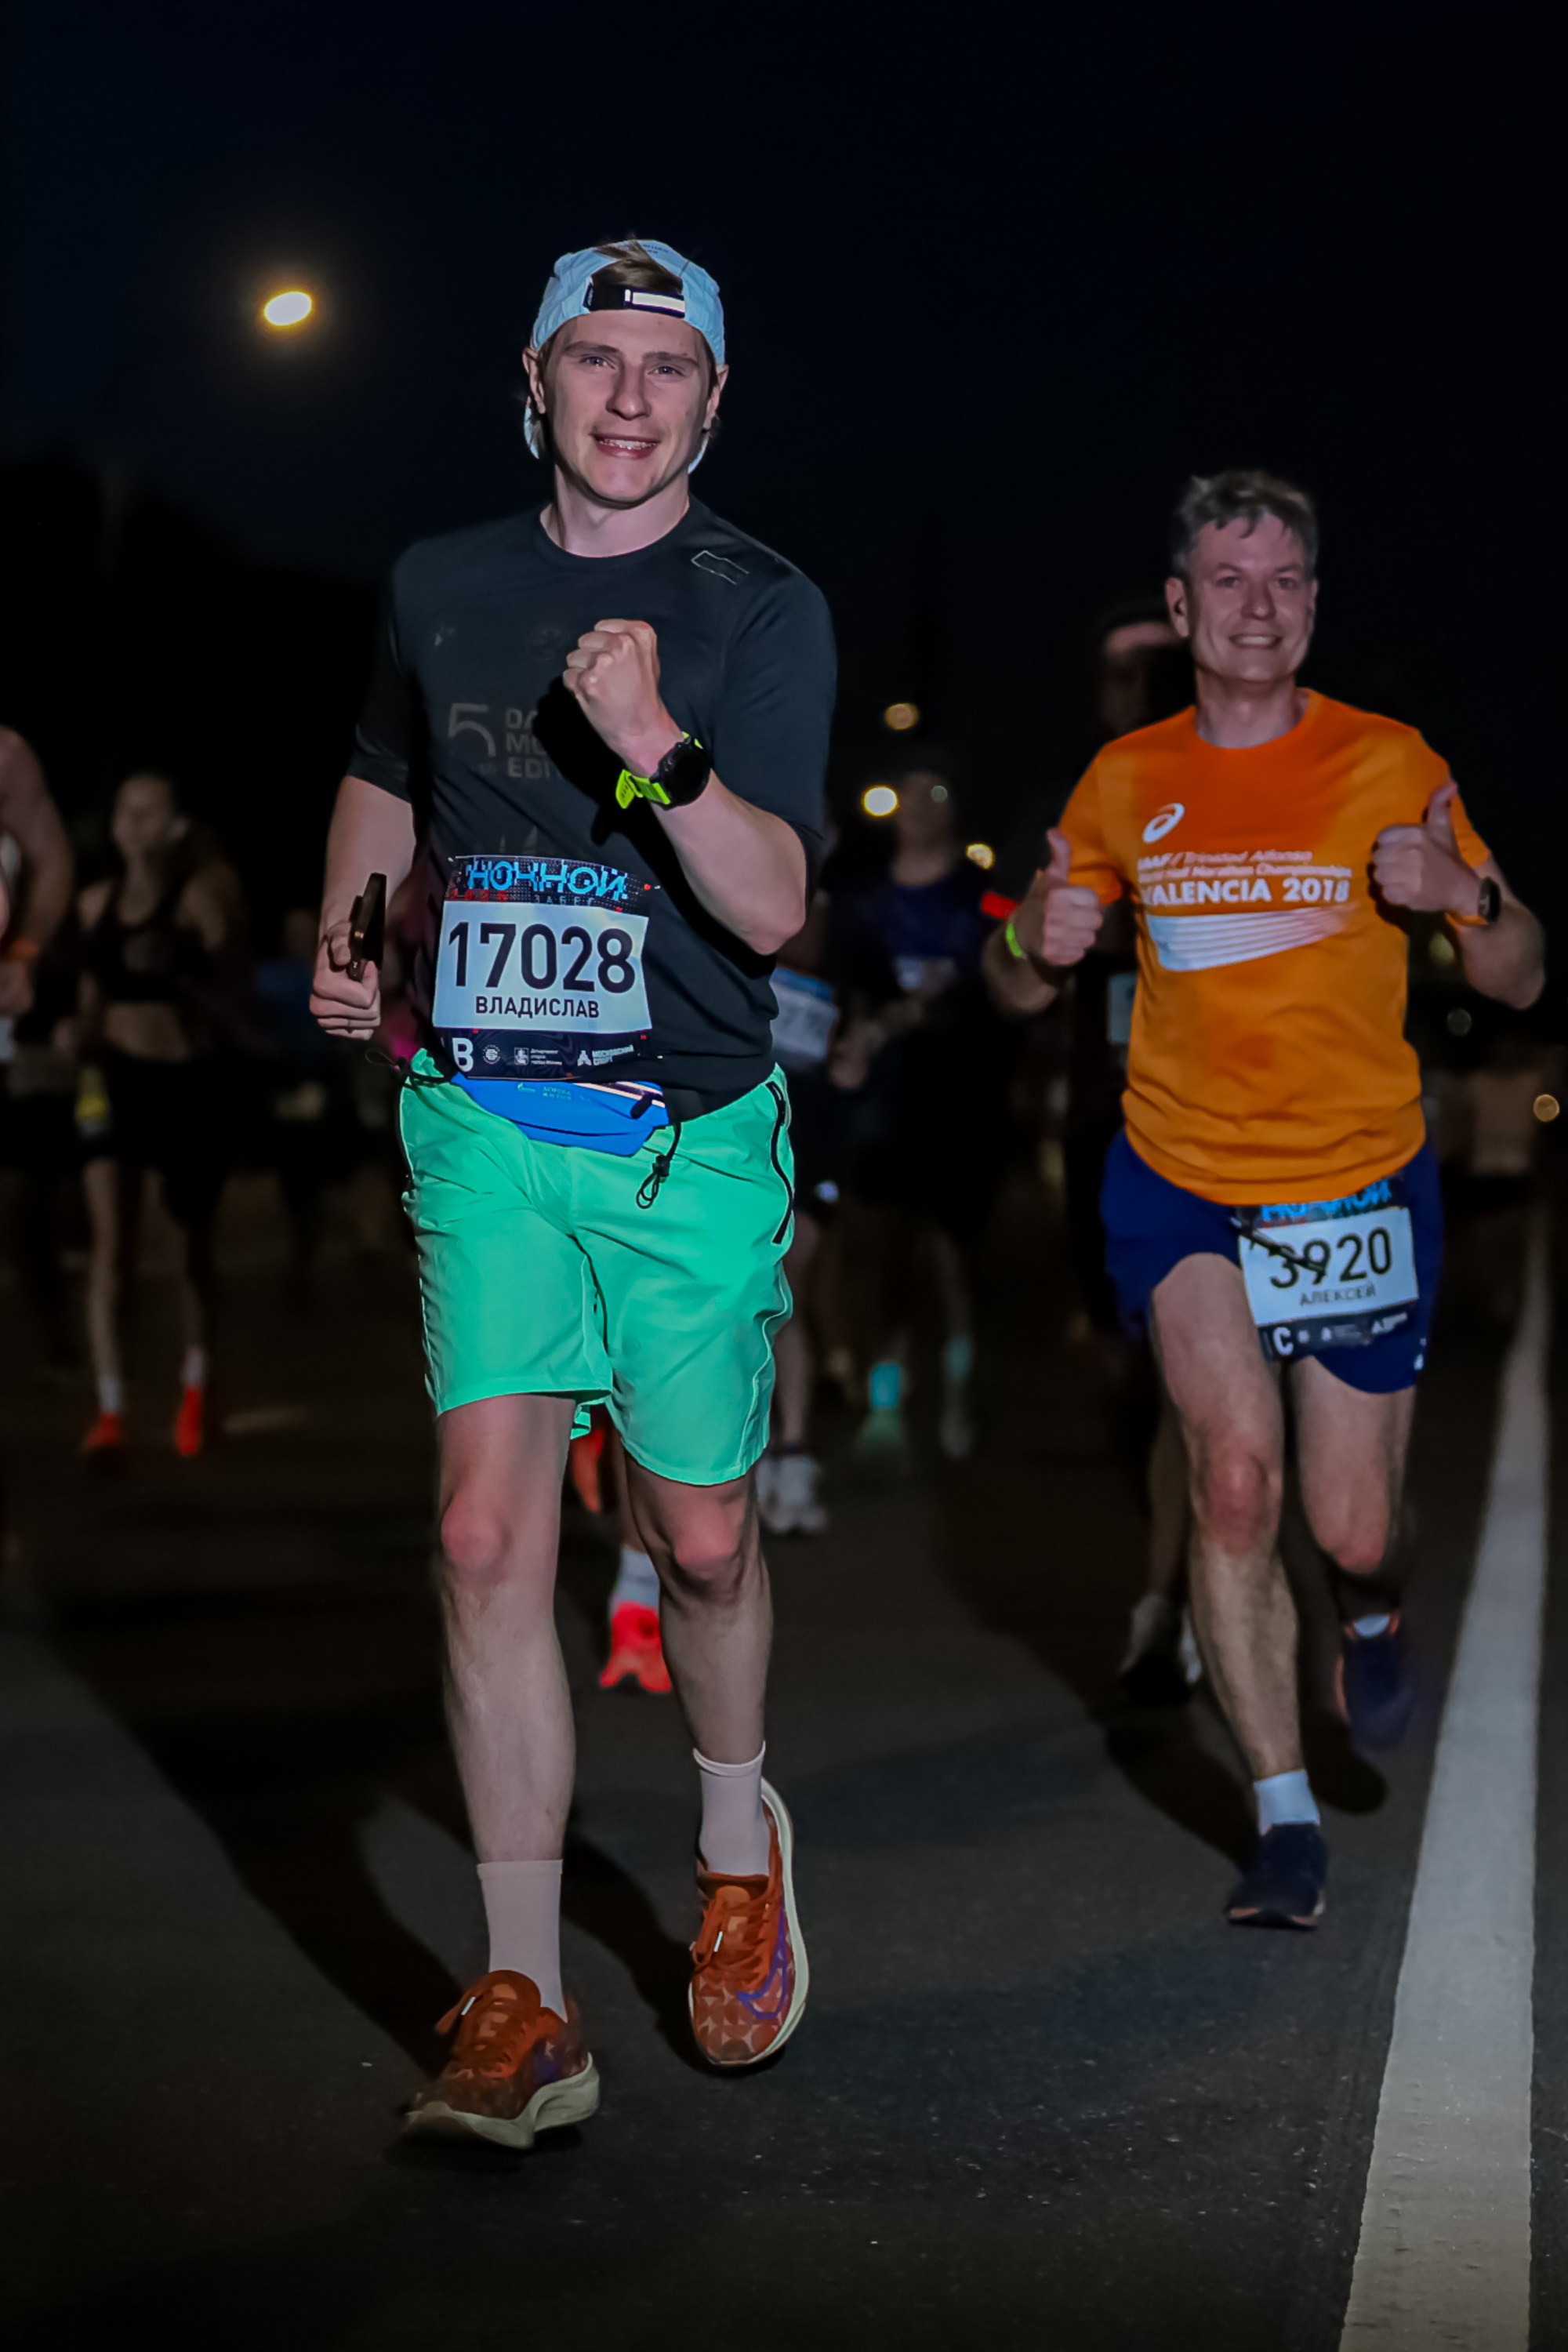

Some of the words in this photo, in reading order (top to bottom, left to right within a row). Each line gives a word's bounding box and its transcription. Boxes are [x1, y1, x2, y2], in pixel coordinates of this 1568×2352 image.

[466, 859, 628, 901] НОЧНОЙ
[1282, 877, 1350, 902] 2018
[448, 921, 636, 994] 17028
[475, 996, 600, 1018] ВЛАДИСЛАВ
[1269, 1226, 1392, 1289] 3920
